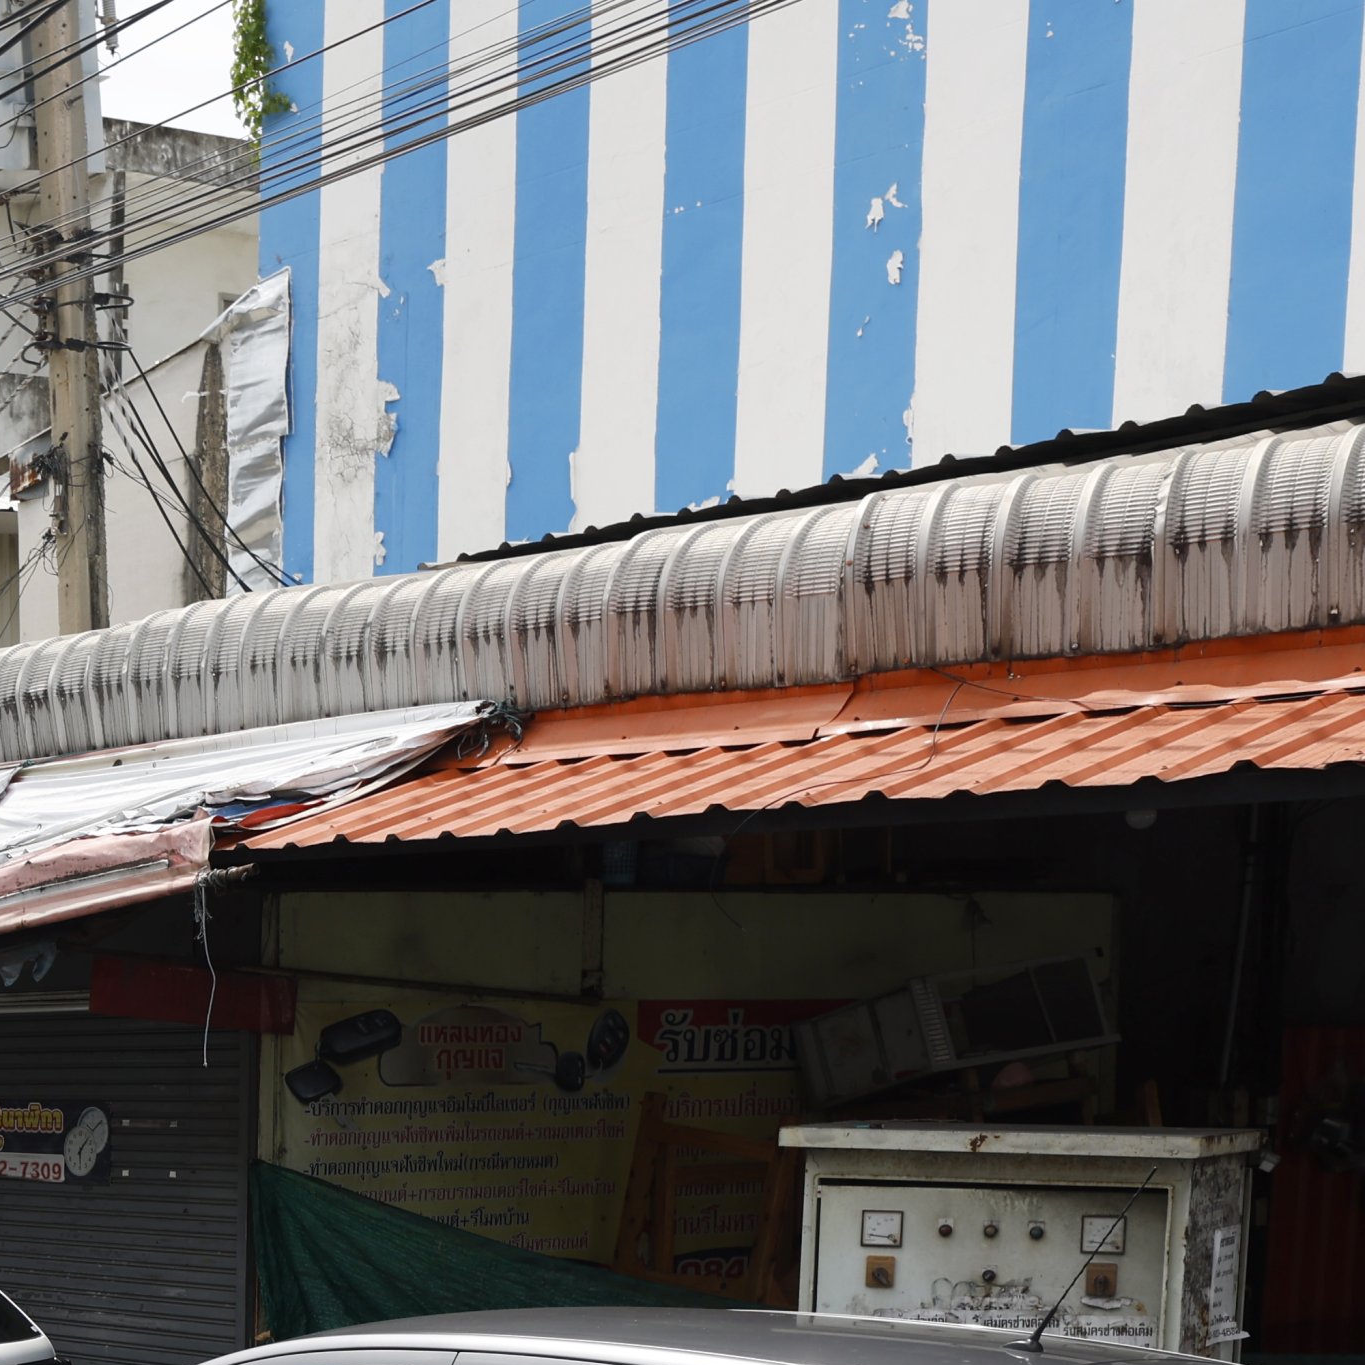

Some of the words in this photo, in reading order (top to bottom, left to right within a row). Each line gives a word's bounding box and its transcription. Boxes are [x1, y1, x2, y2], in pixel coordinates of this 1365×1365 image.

[418, 1022, 523, 1046] แหลมทอง
[656, 1011, 796, 1063] รับซ่อม
[435, 1048, 506, 1081] กุญแจ
